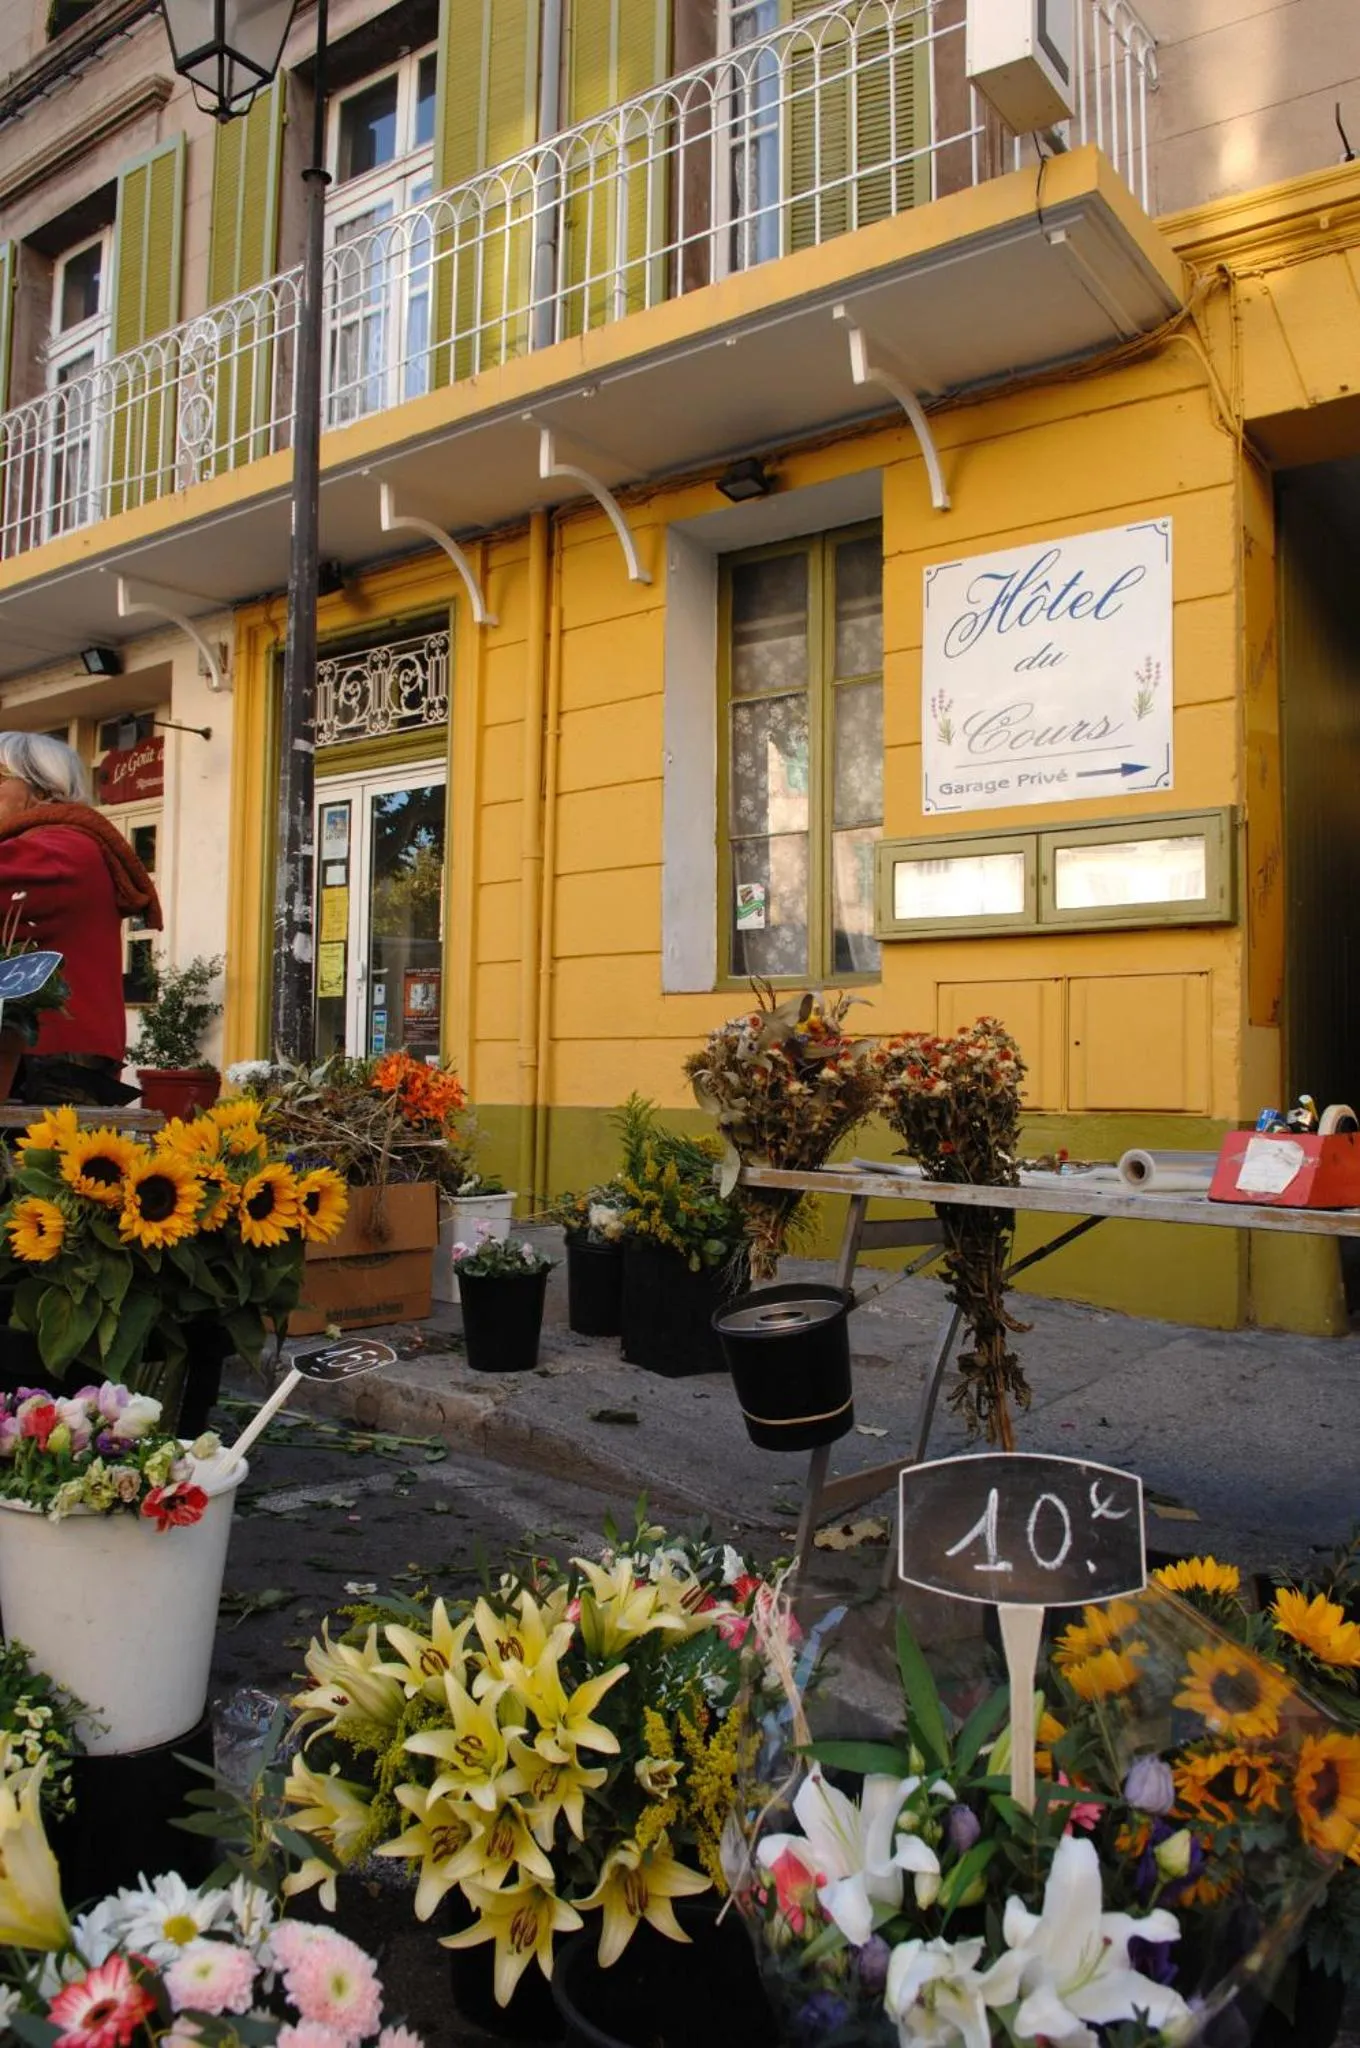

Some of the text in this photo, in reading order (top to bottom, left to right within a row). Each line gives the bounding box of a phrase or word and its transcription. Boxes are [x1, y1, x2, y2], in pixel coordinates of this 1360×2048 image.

[944, 548, 1146, 658] Hôtel
[1014, 642, 1069, 672] du
[963, 702, 1124, 754] Cours
[112, 763, 127, 784] Le
[939, 768, 1069, 797] Garage Privé
